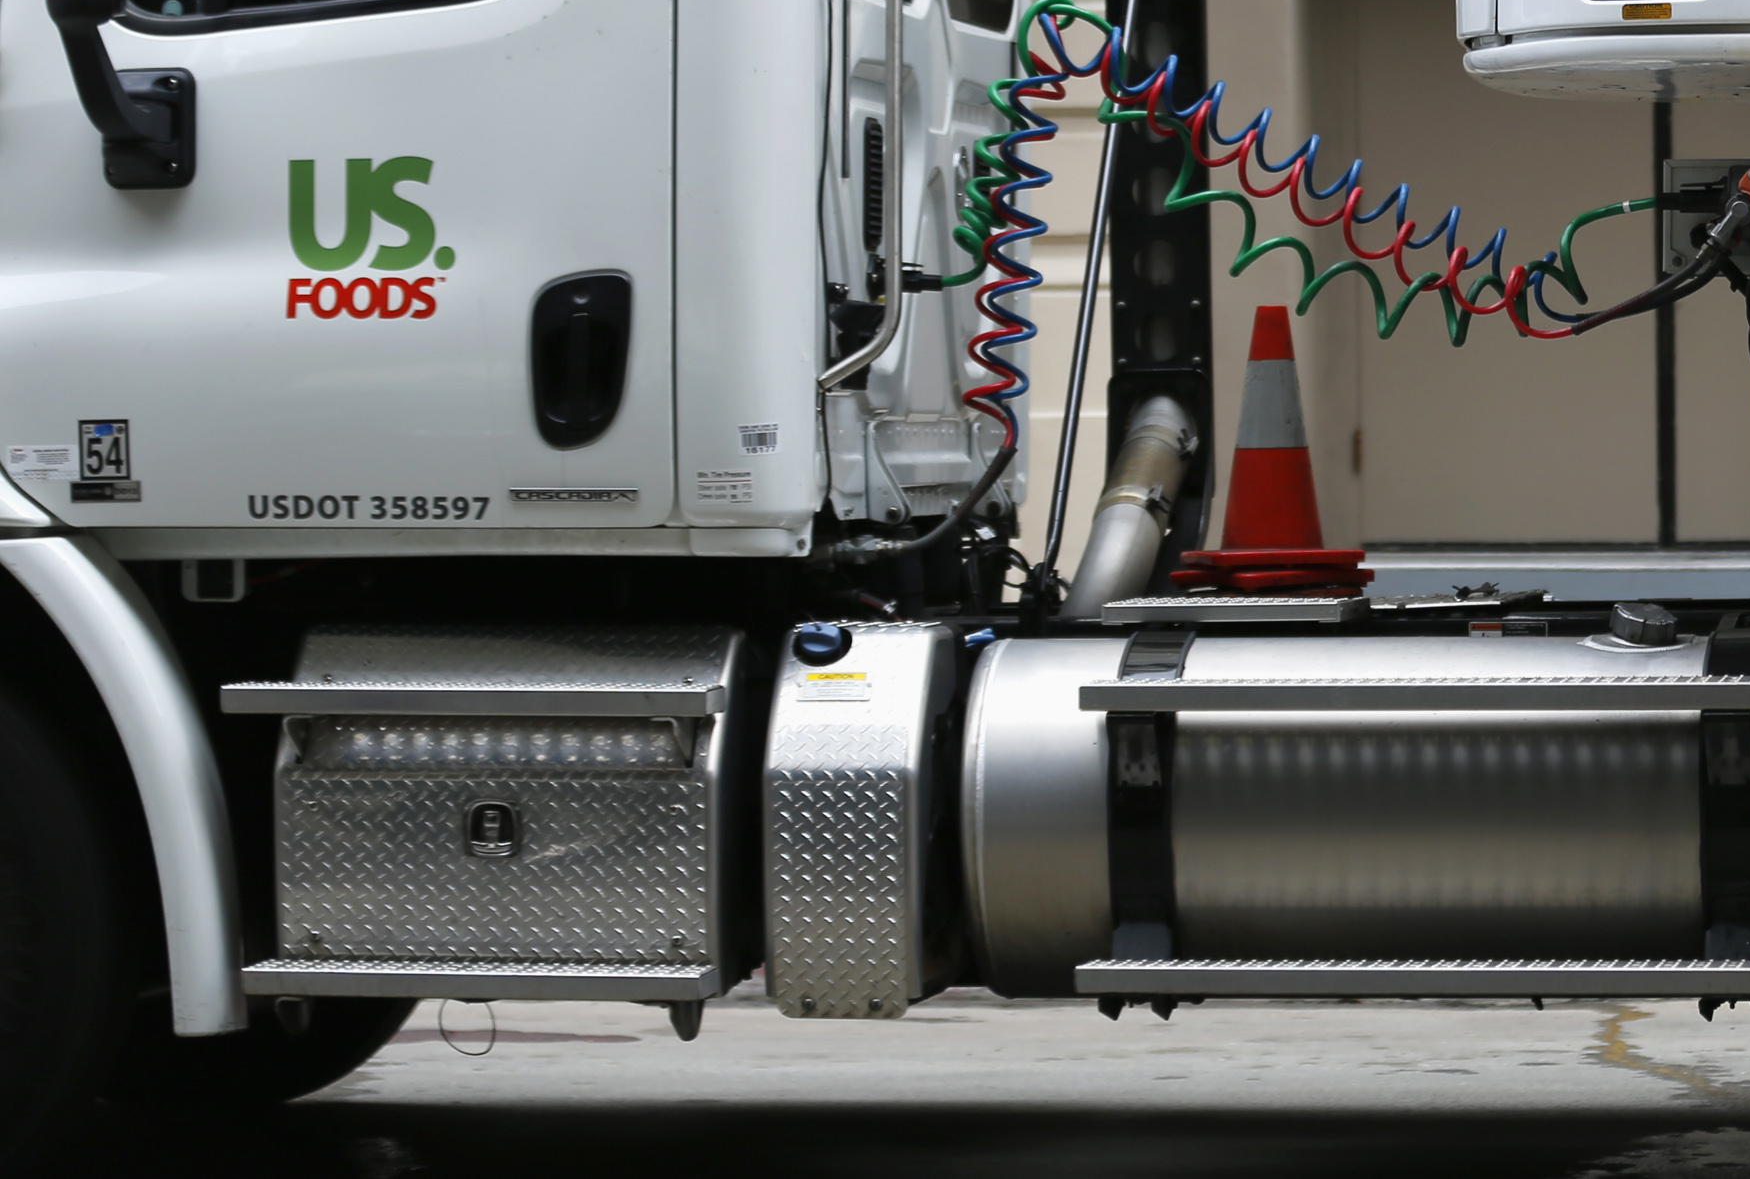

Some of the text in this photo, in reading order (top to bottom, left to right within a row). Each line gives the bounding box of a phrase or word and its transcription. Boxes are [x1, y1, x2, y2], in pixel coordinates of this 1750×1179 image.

[288, 156, 456, 271] US.
[86, 436, 124, 475] 54
[247, 494, 490, 521] USDOT 358597
[515, 491, 612, 500] CASCADIA
